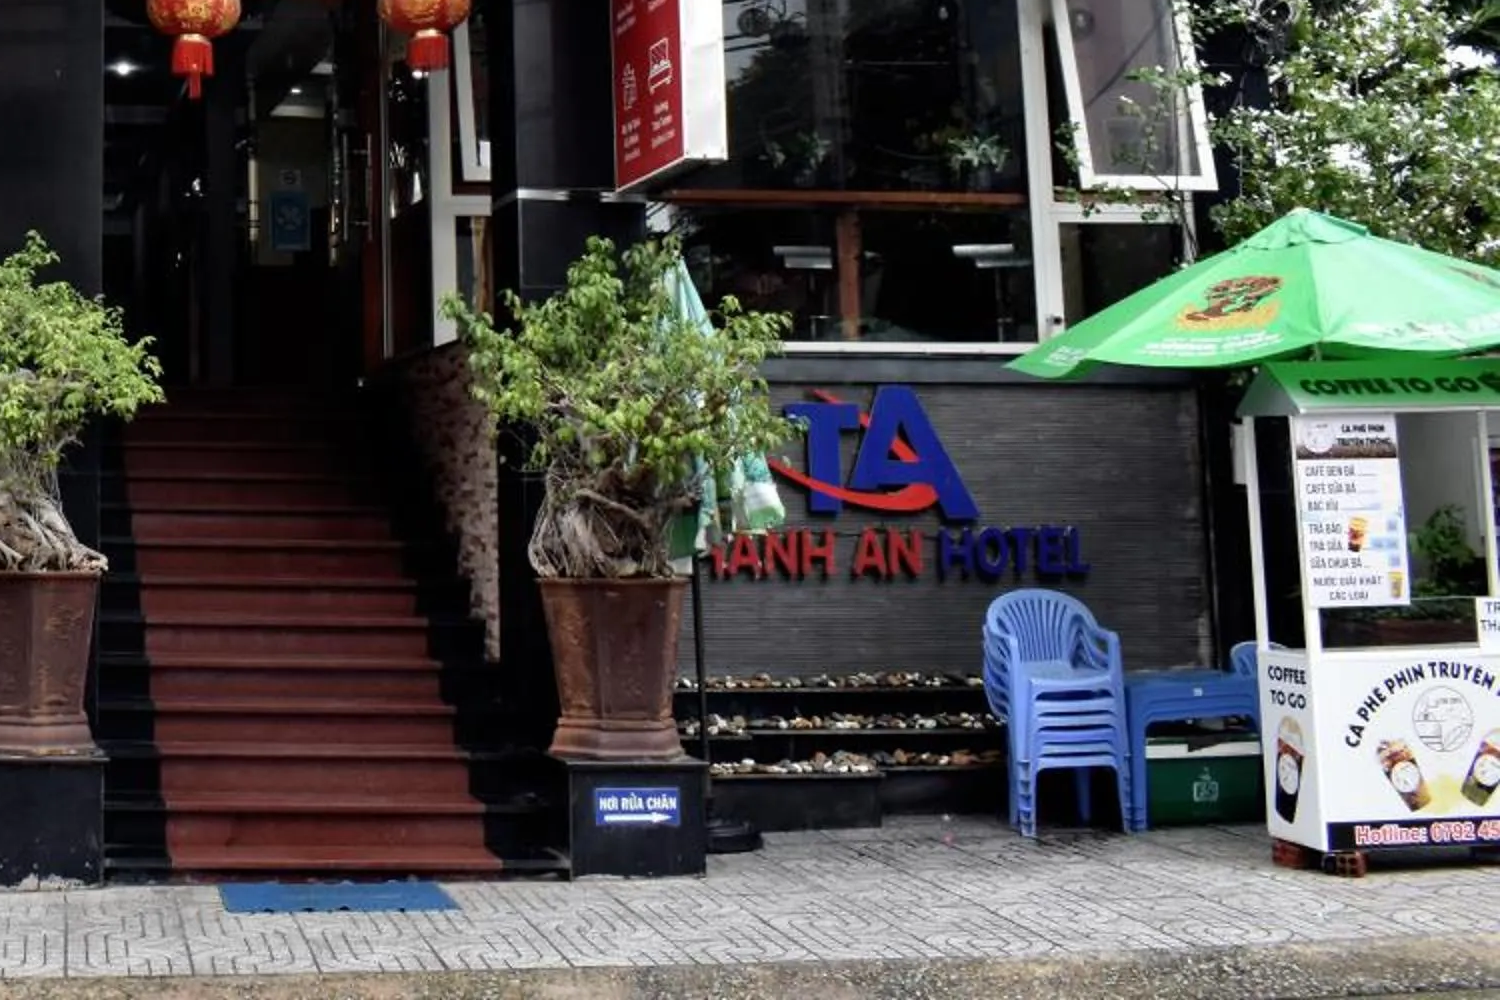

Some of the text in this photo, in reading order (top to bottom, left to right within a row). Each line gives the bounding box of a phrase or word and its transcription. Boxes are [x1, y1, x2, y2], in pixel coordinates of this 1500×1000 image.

[1391, 376, 1434, 394] TO
[1434, 376, 1482, 394] GO
[710, 525, 1092, 579] ANH AN HOTEL
[1267, 665, 1307, 685] COFFEE
[1384, 663, 1425, 694] PHIN
[1270, 689, 1307, 710] TO GO
[1354, 822, 1428, 846] Hotline:
